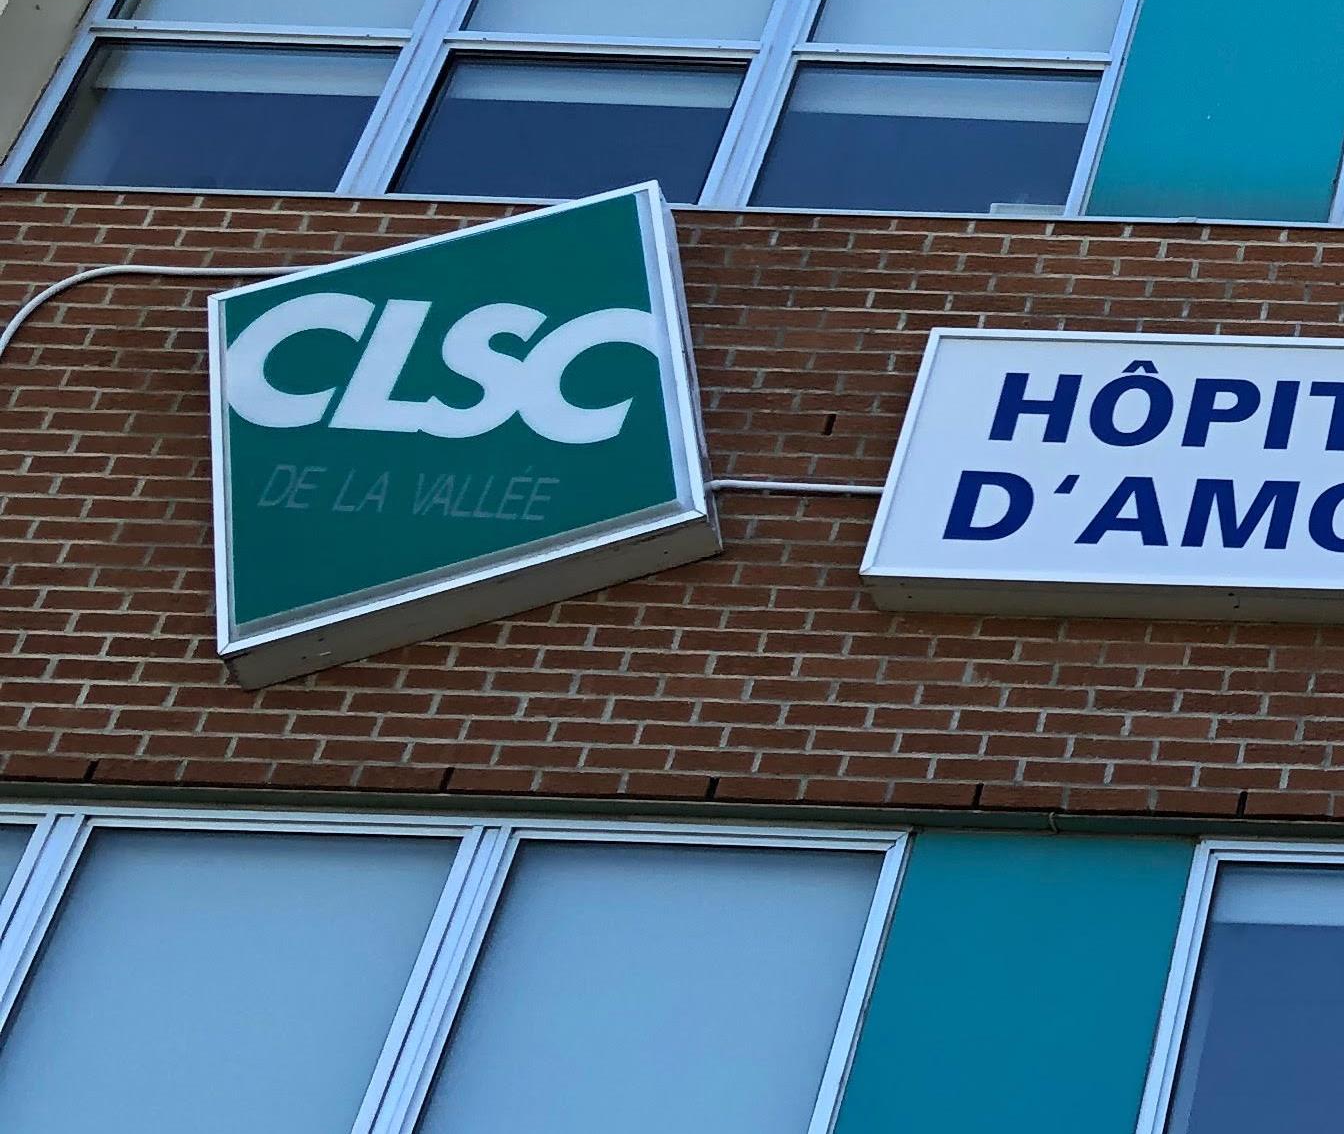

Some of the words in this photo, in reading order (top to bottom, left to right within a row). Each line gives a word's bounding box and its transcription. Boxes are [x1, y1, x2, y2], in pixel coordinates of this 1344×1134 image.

[227, 292, 660, 444] CLSC
[257, 464, 327, 510] DE
[332, 468, 390, 513] LA
[412, 465, 560, 520] VALLÉE
